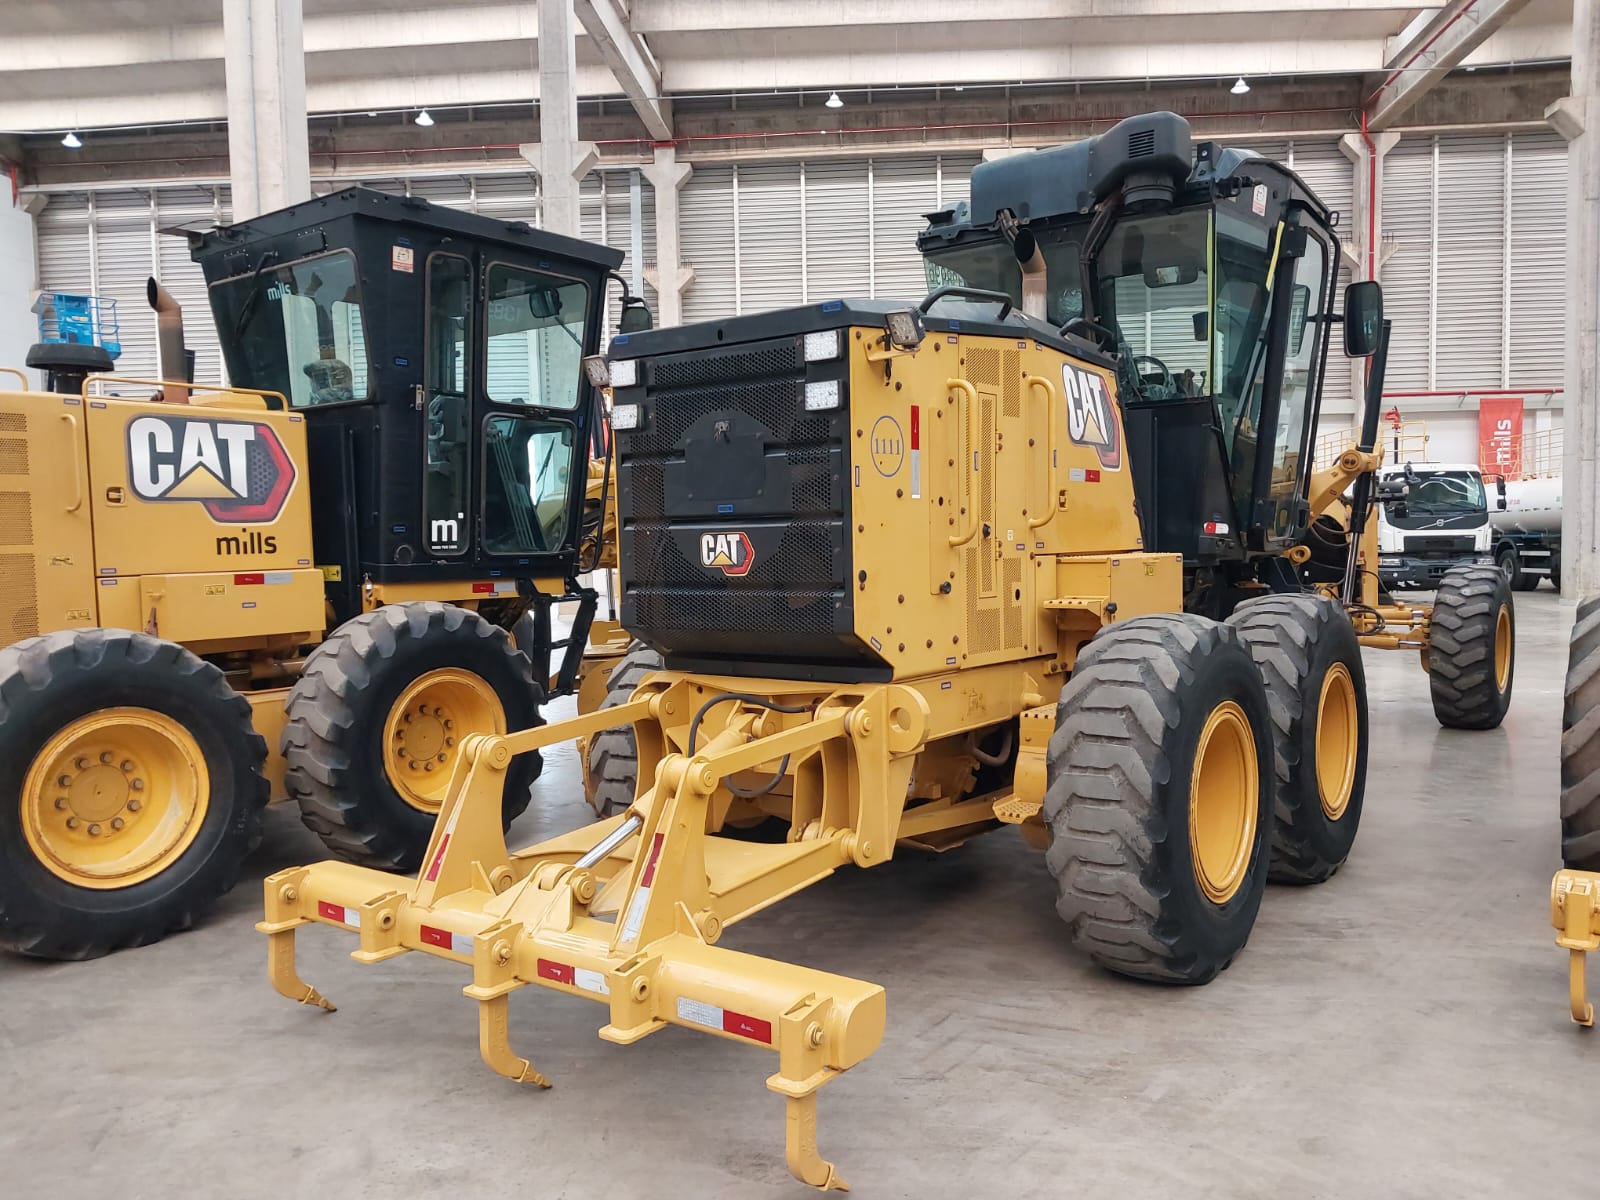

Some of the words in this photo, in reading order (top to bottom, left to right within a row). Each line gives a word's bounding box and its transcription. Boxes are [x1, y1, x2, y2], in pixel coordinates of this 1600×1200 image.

[267, 281, 291, 300] mills
[1062, 364, 1109, 445] CAT
[130, 417, 256, 498] CAT
[874, 438, 900, 455] 1111
[1490, 419, 1511, 465] mills
[216, 528, 277, 555] mills
[701, 534, 740, 566] CAT
